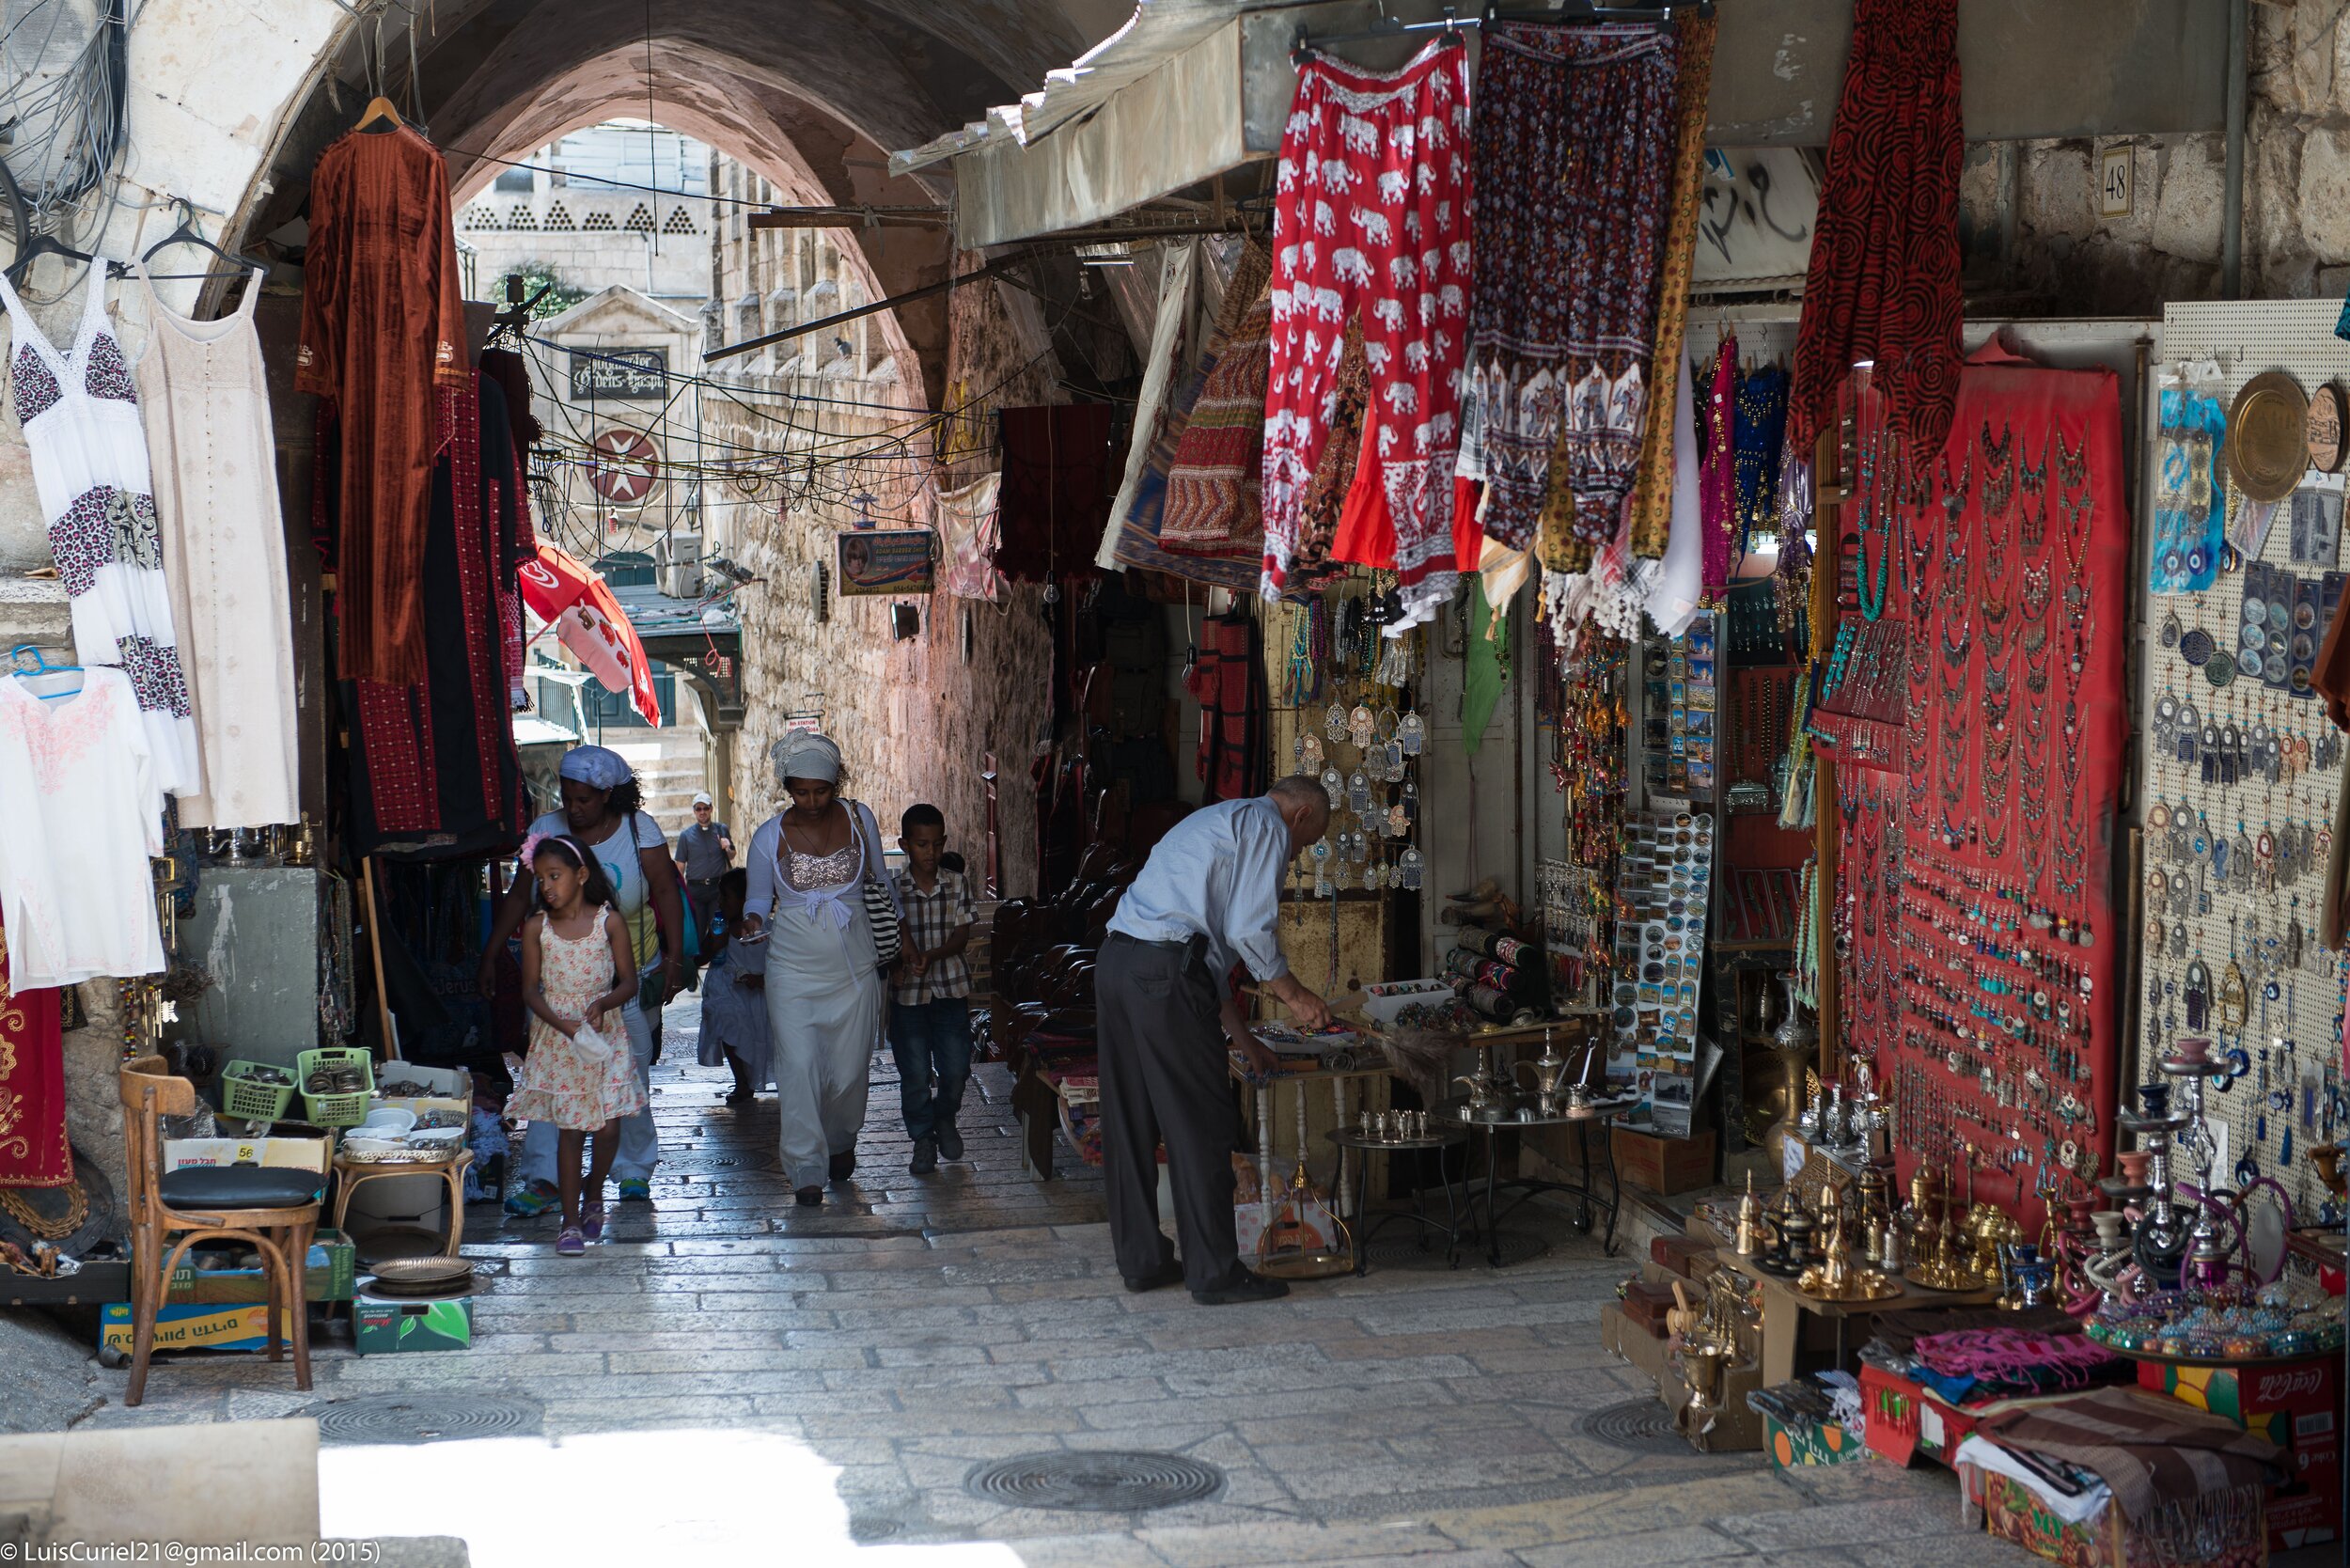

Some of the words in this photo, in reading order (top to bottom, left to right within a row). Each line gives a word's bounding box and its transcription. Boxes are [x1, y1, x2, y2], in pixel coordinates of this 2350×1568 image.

[2106, 165, 2125, 200] 48
[239, 1148, 254, 1158] 56
[341, 1248, 351, 1272] fruits
[333, 1248, 342, 1295] vegetables
[193, 1318, 239, 1337] הדרים
[2258, 1368, 2323, 1403] Coca-Cola
[2298, 1452, 2310, 1470] 6
[2311, 1451, 2336, 1463] Coke
